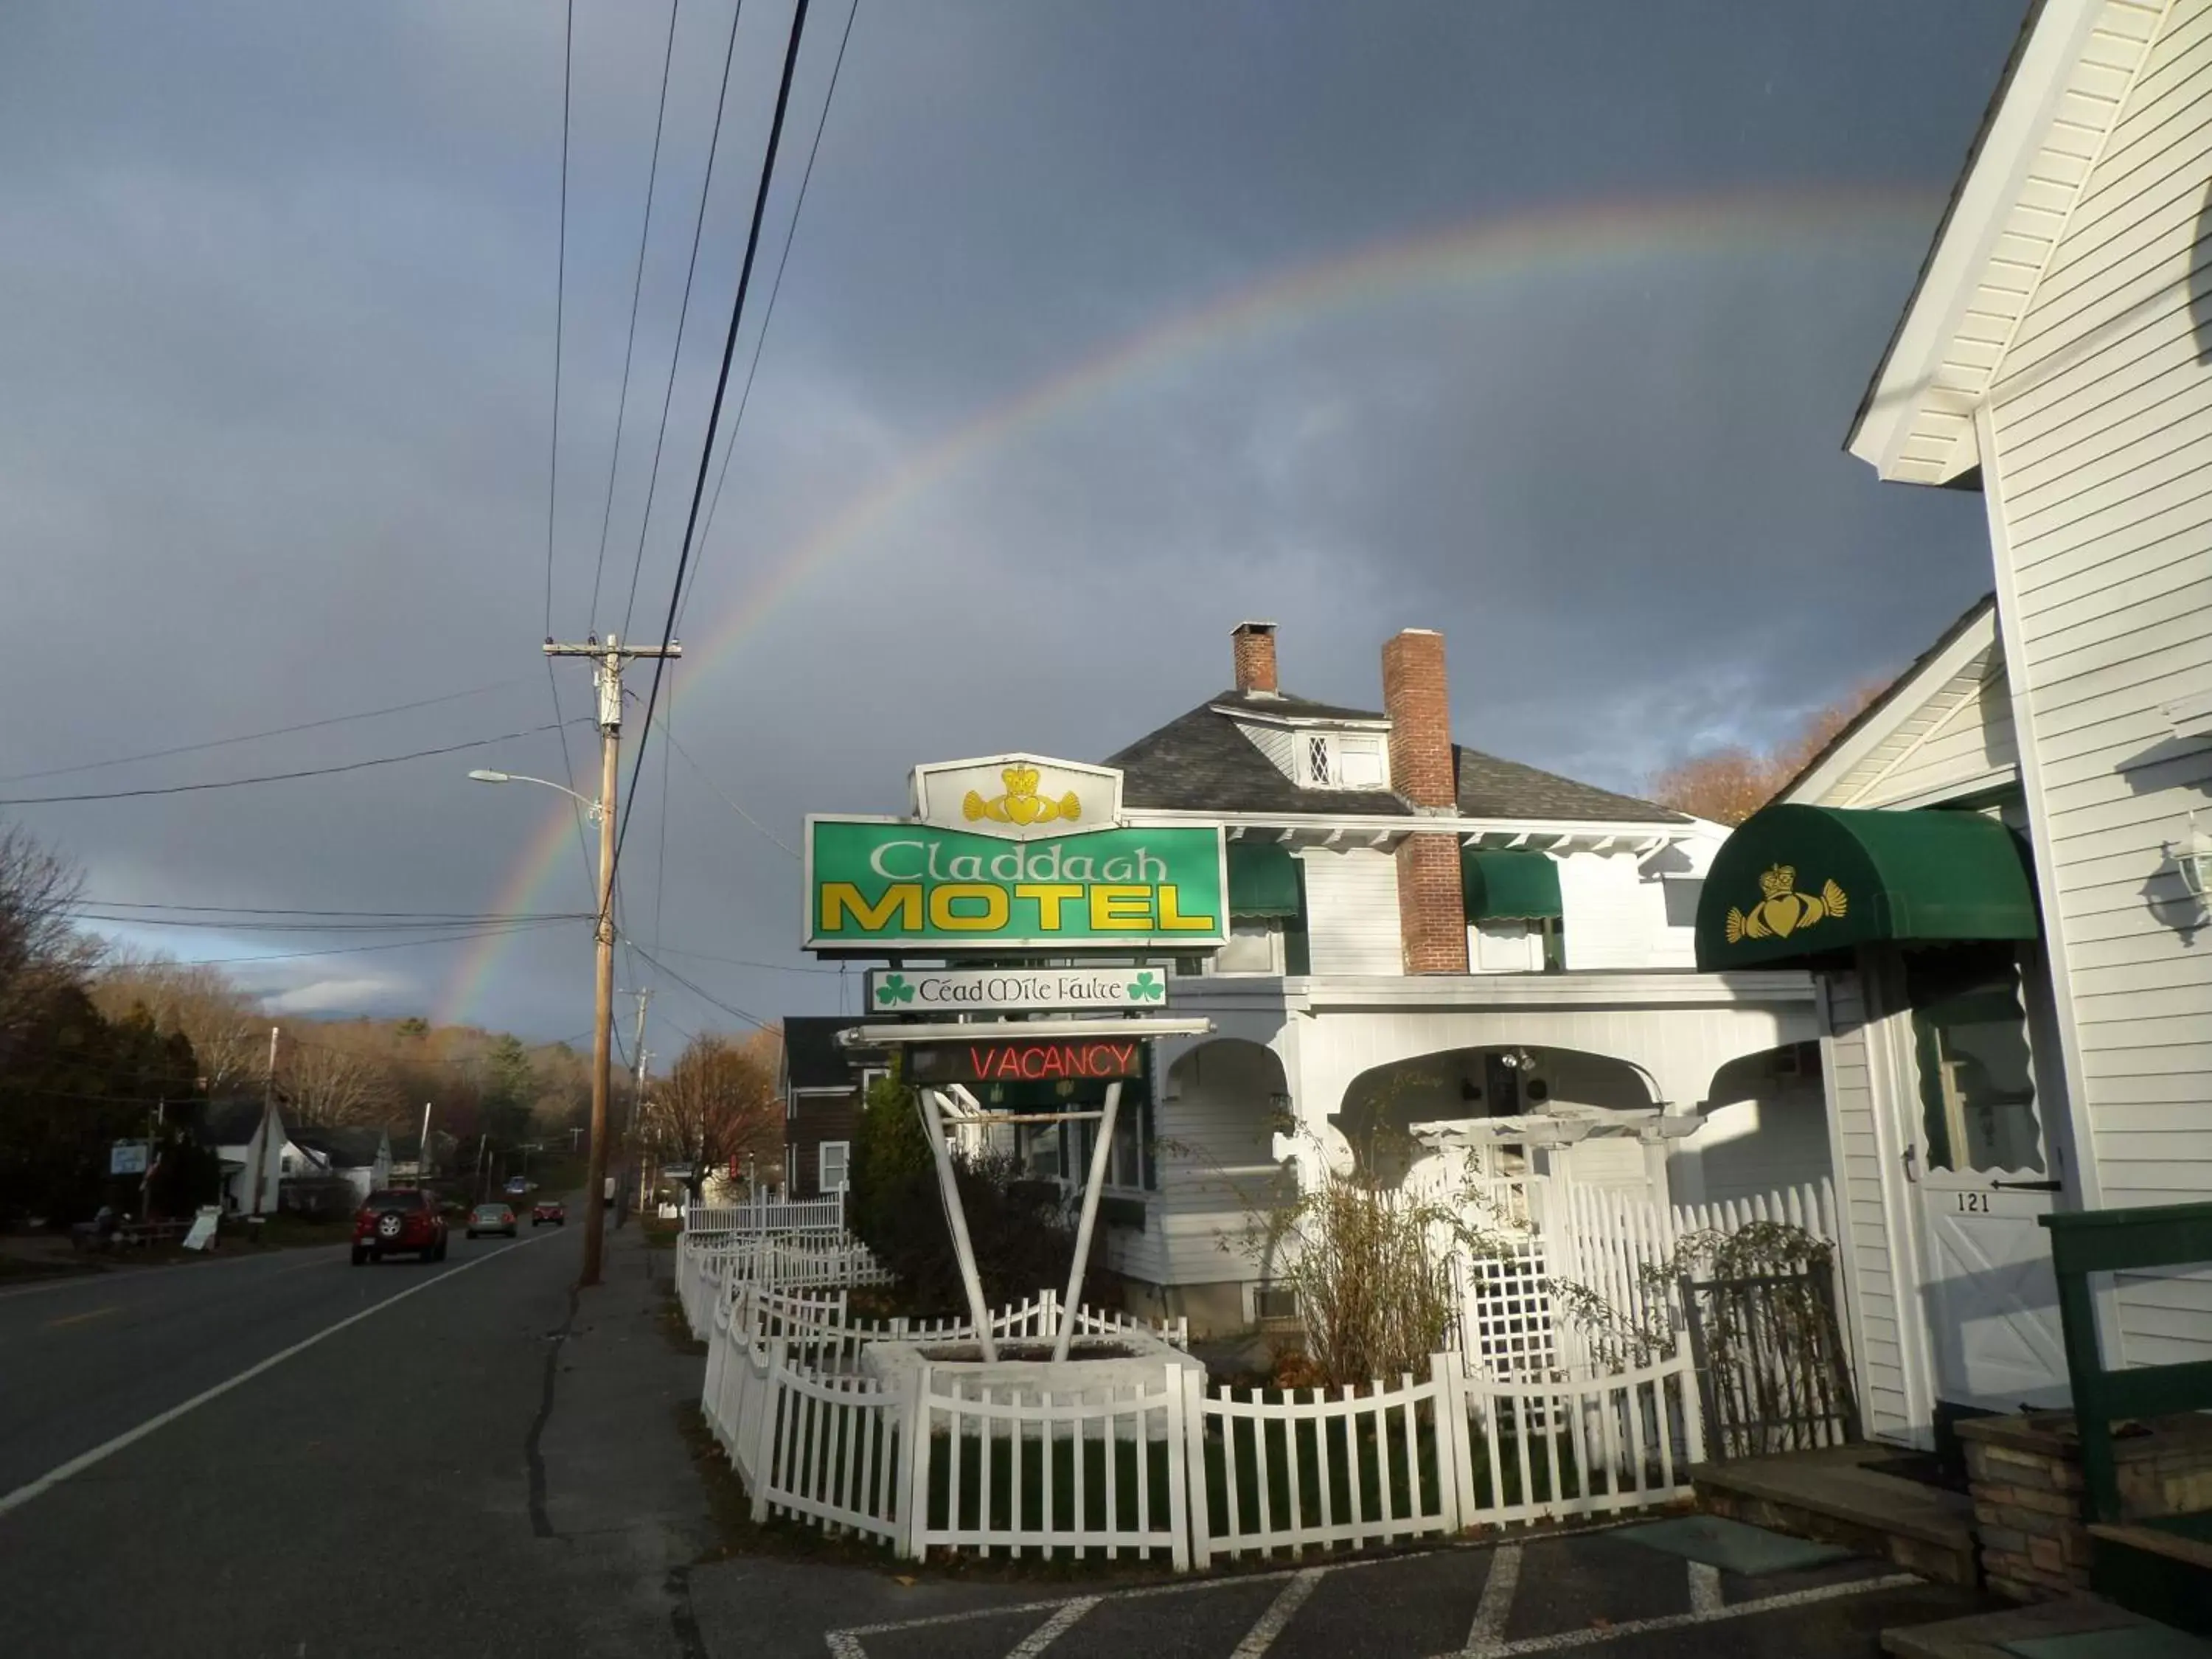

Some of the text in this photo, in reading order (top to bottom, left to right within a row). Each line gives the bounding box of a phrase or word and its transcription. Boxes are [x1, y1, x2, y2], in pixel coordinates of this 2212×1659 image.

[869, 841, 1168, 882] Claddagh
[820, 882, 1215, 932] MOTEL
[919, 978, 984, 1002] Céad
[970, 1043, 1133, 1080] VACANCY
[1958, 1193, 1990, 1213] 121
